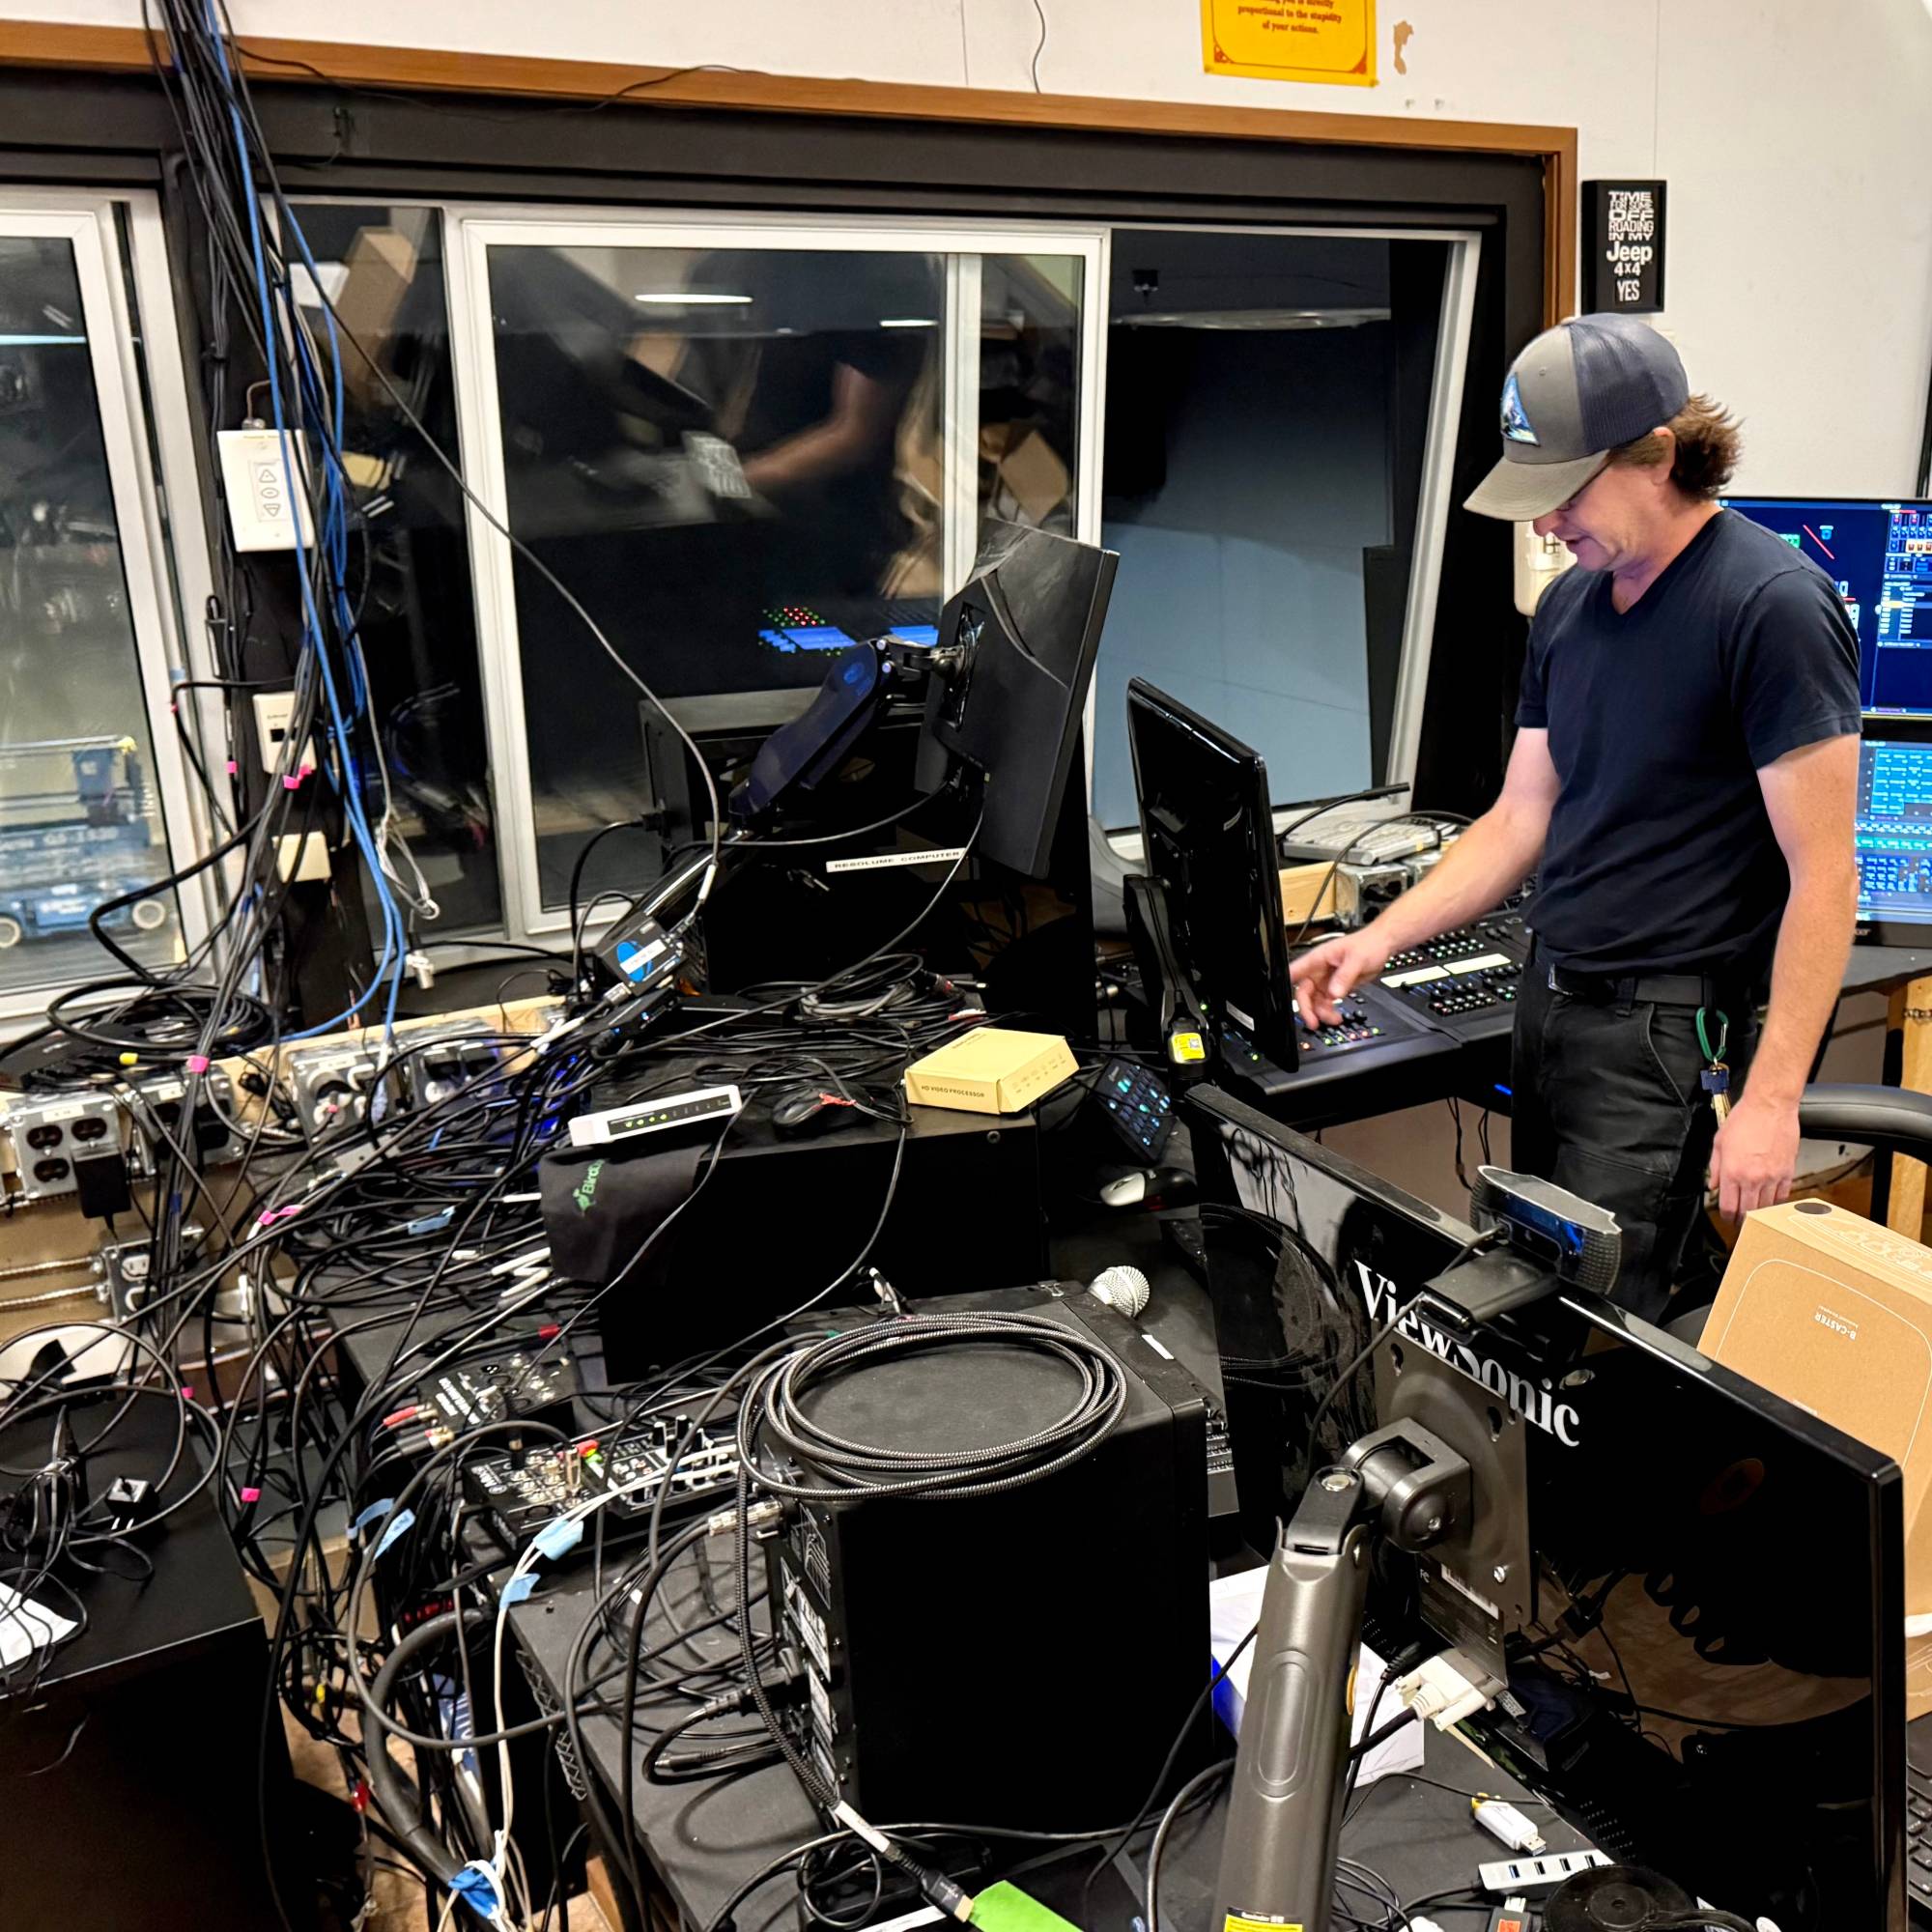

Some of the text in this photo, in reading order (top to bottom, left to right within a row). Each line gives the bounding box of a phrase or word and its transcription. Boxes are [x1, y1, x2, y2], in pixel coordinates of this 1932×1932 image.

[1237, 6, 1284, 16] proportional
[1296, 10, 1308, 19] the
[1310, 12, 1342, 23] stupidity
[1262, 20, 1270, 30] of
[1271, 22, 1289, 32] your
[1607, 191, 1652, 202] TIME
[1610, 200, 1628, 211] FOR
[1608, 209, 1654, 221] OFF
[1608, 220, 1654, 233] ROADING
[1608, 232, 1654, 242] IN MY
[1605, 241, 1653, 266] Jeep
[1616, 279, 1640, 302] YES
[901, 851, 960, 863] COMPUTER
[930, 1086, 948, 1094] VIDEO
[950, 1089, 985, 1098] PROCESSOR
[1813, 1311, 1858, 1342] B-CASTER
